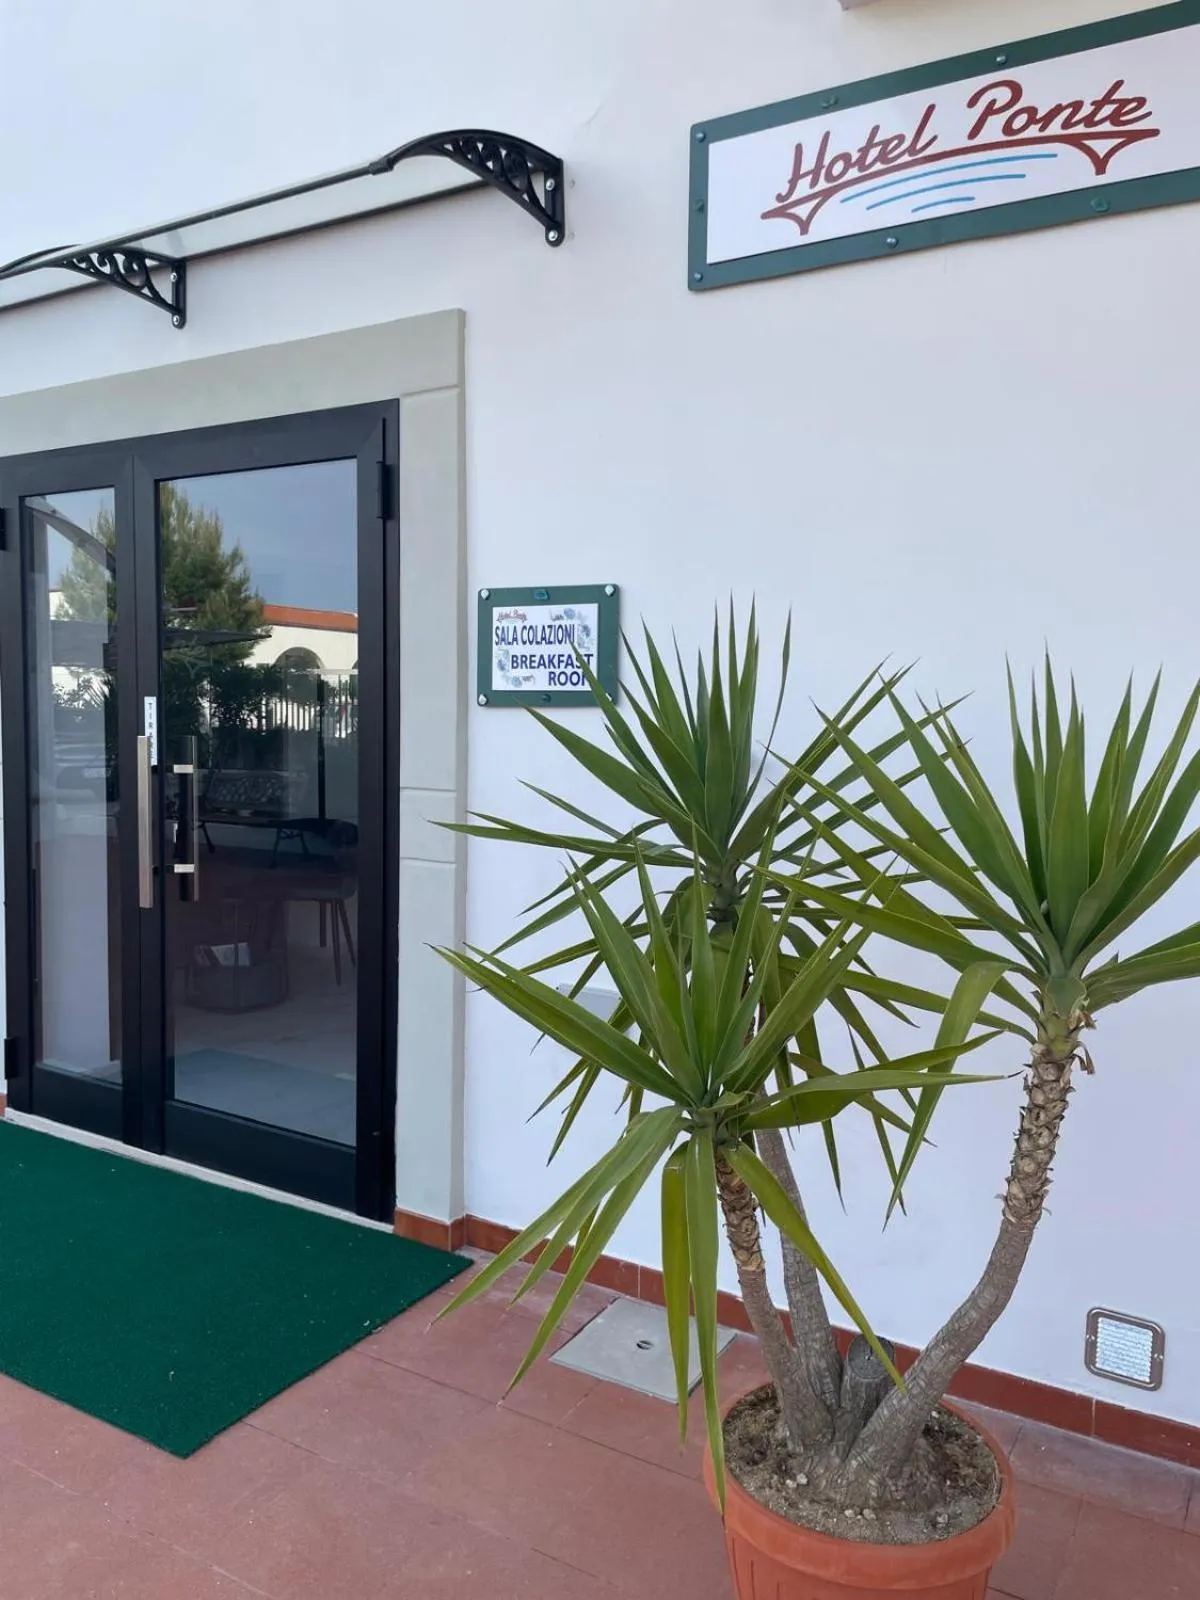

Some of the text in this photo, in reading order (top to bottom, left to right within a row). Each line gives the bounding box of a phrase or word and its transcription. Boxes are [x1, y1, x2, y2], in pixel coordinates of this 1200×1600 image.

[775, 79, 1153, 203] Hotel Ponte
[495, 624, 575, 645] SALA COLAZIONI
